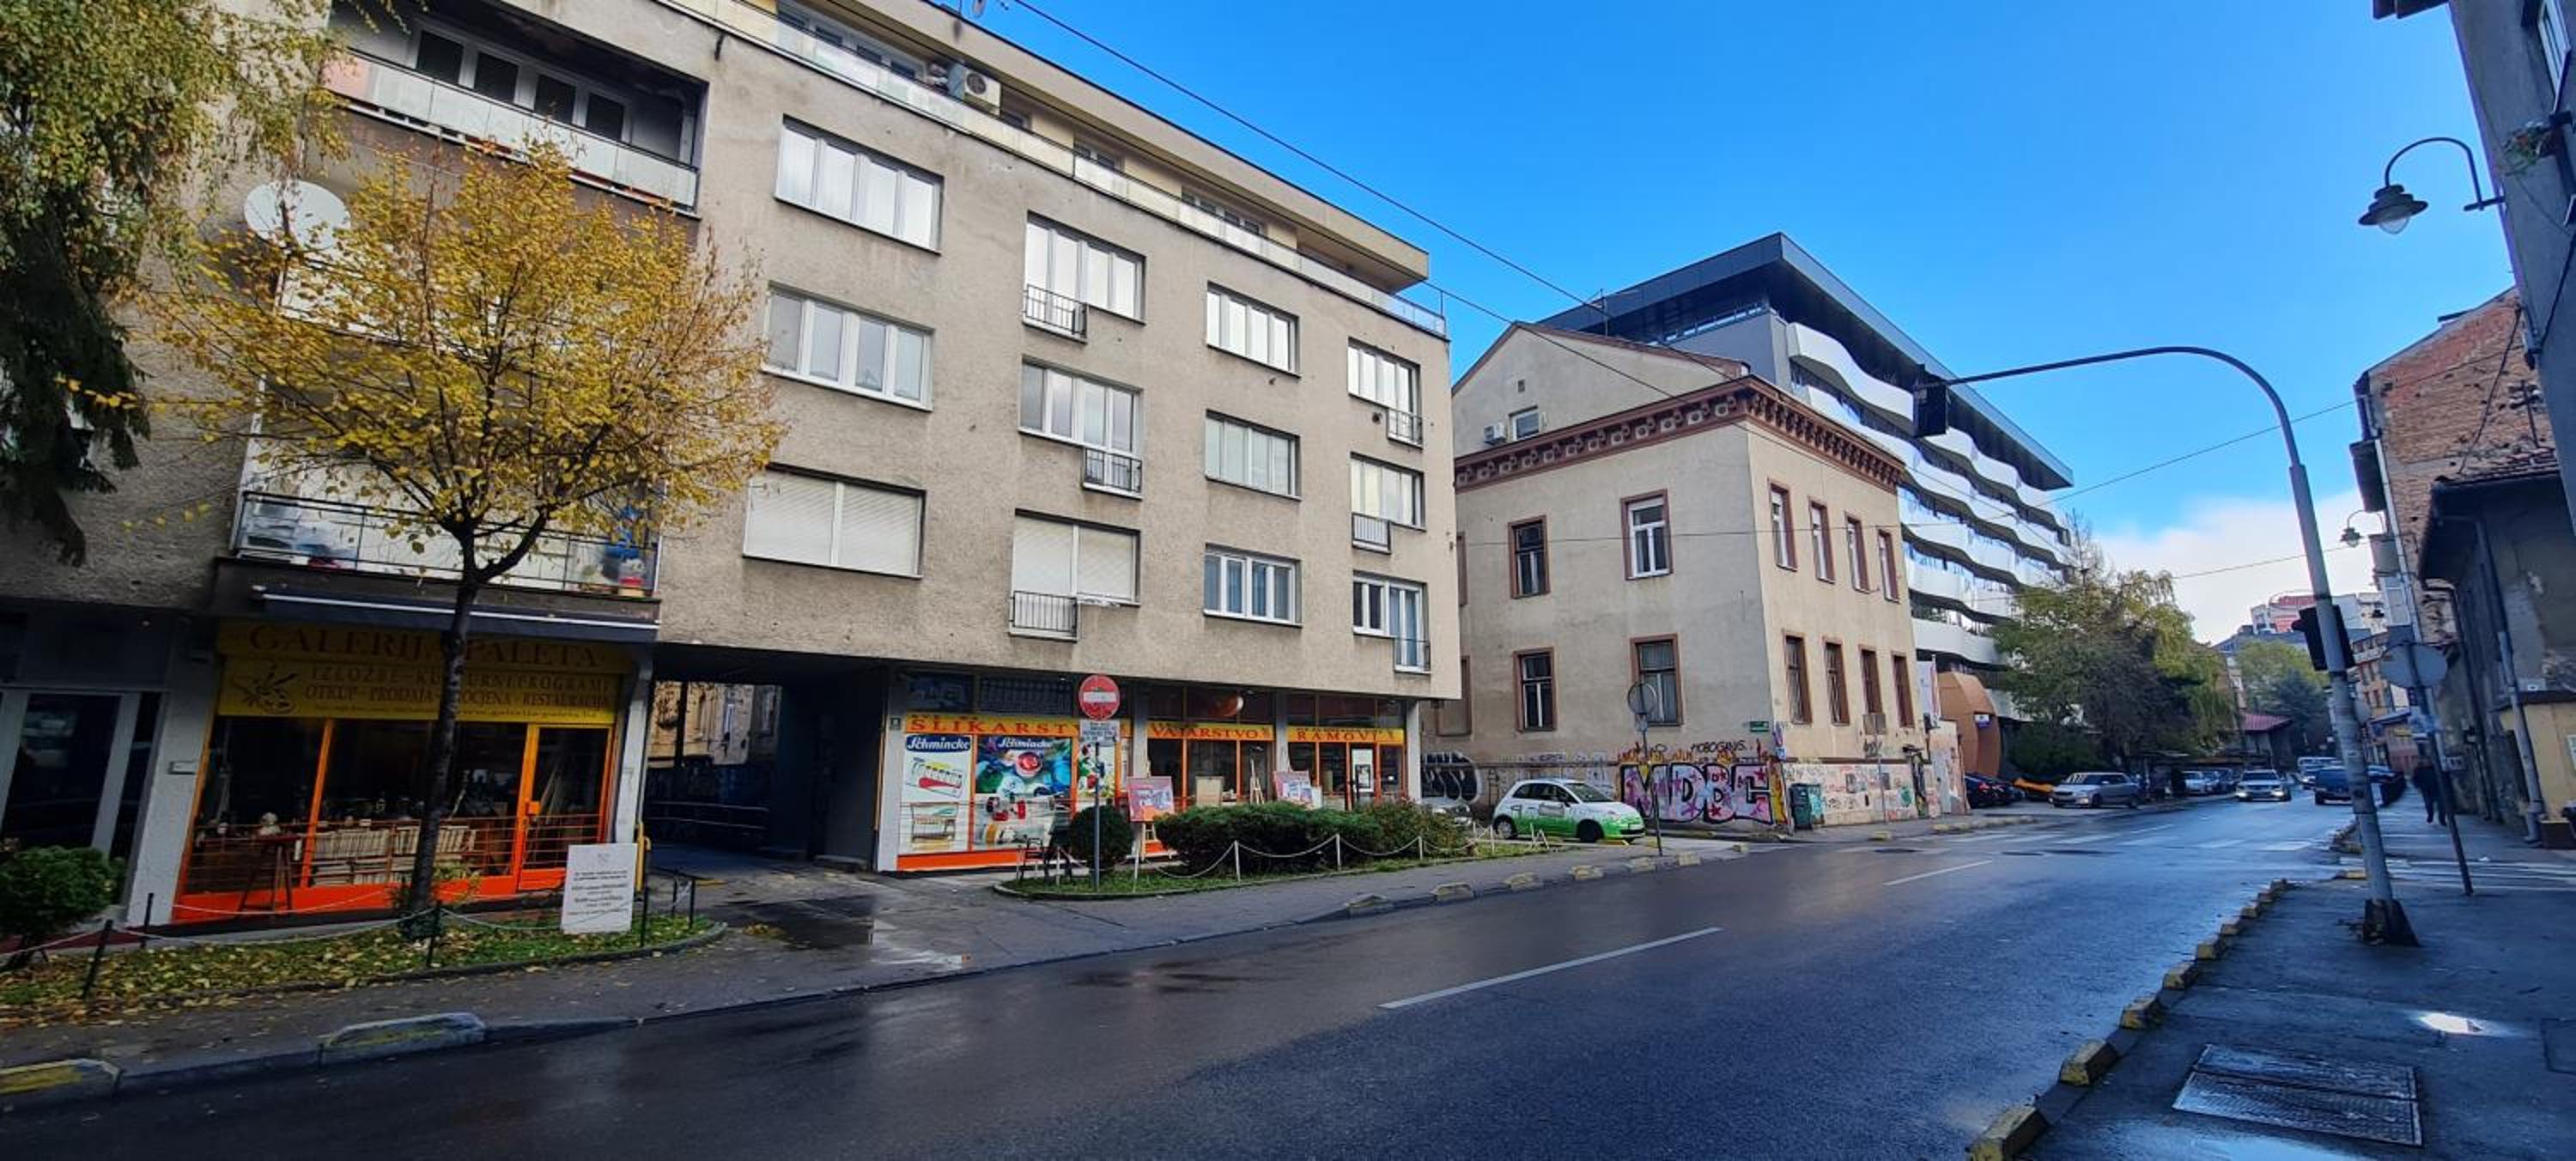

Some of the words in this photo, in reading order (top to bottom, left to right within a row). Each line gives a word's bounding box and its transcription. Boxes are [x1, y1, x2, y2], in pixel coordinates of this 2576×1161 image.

[249, 624, 440, 660] GALERIJ
[465, 641, 605, 668] PALETA
[1153, 727, 1258, 739] VAJARSTVO
